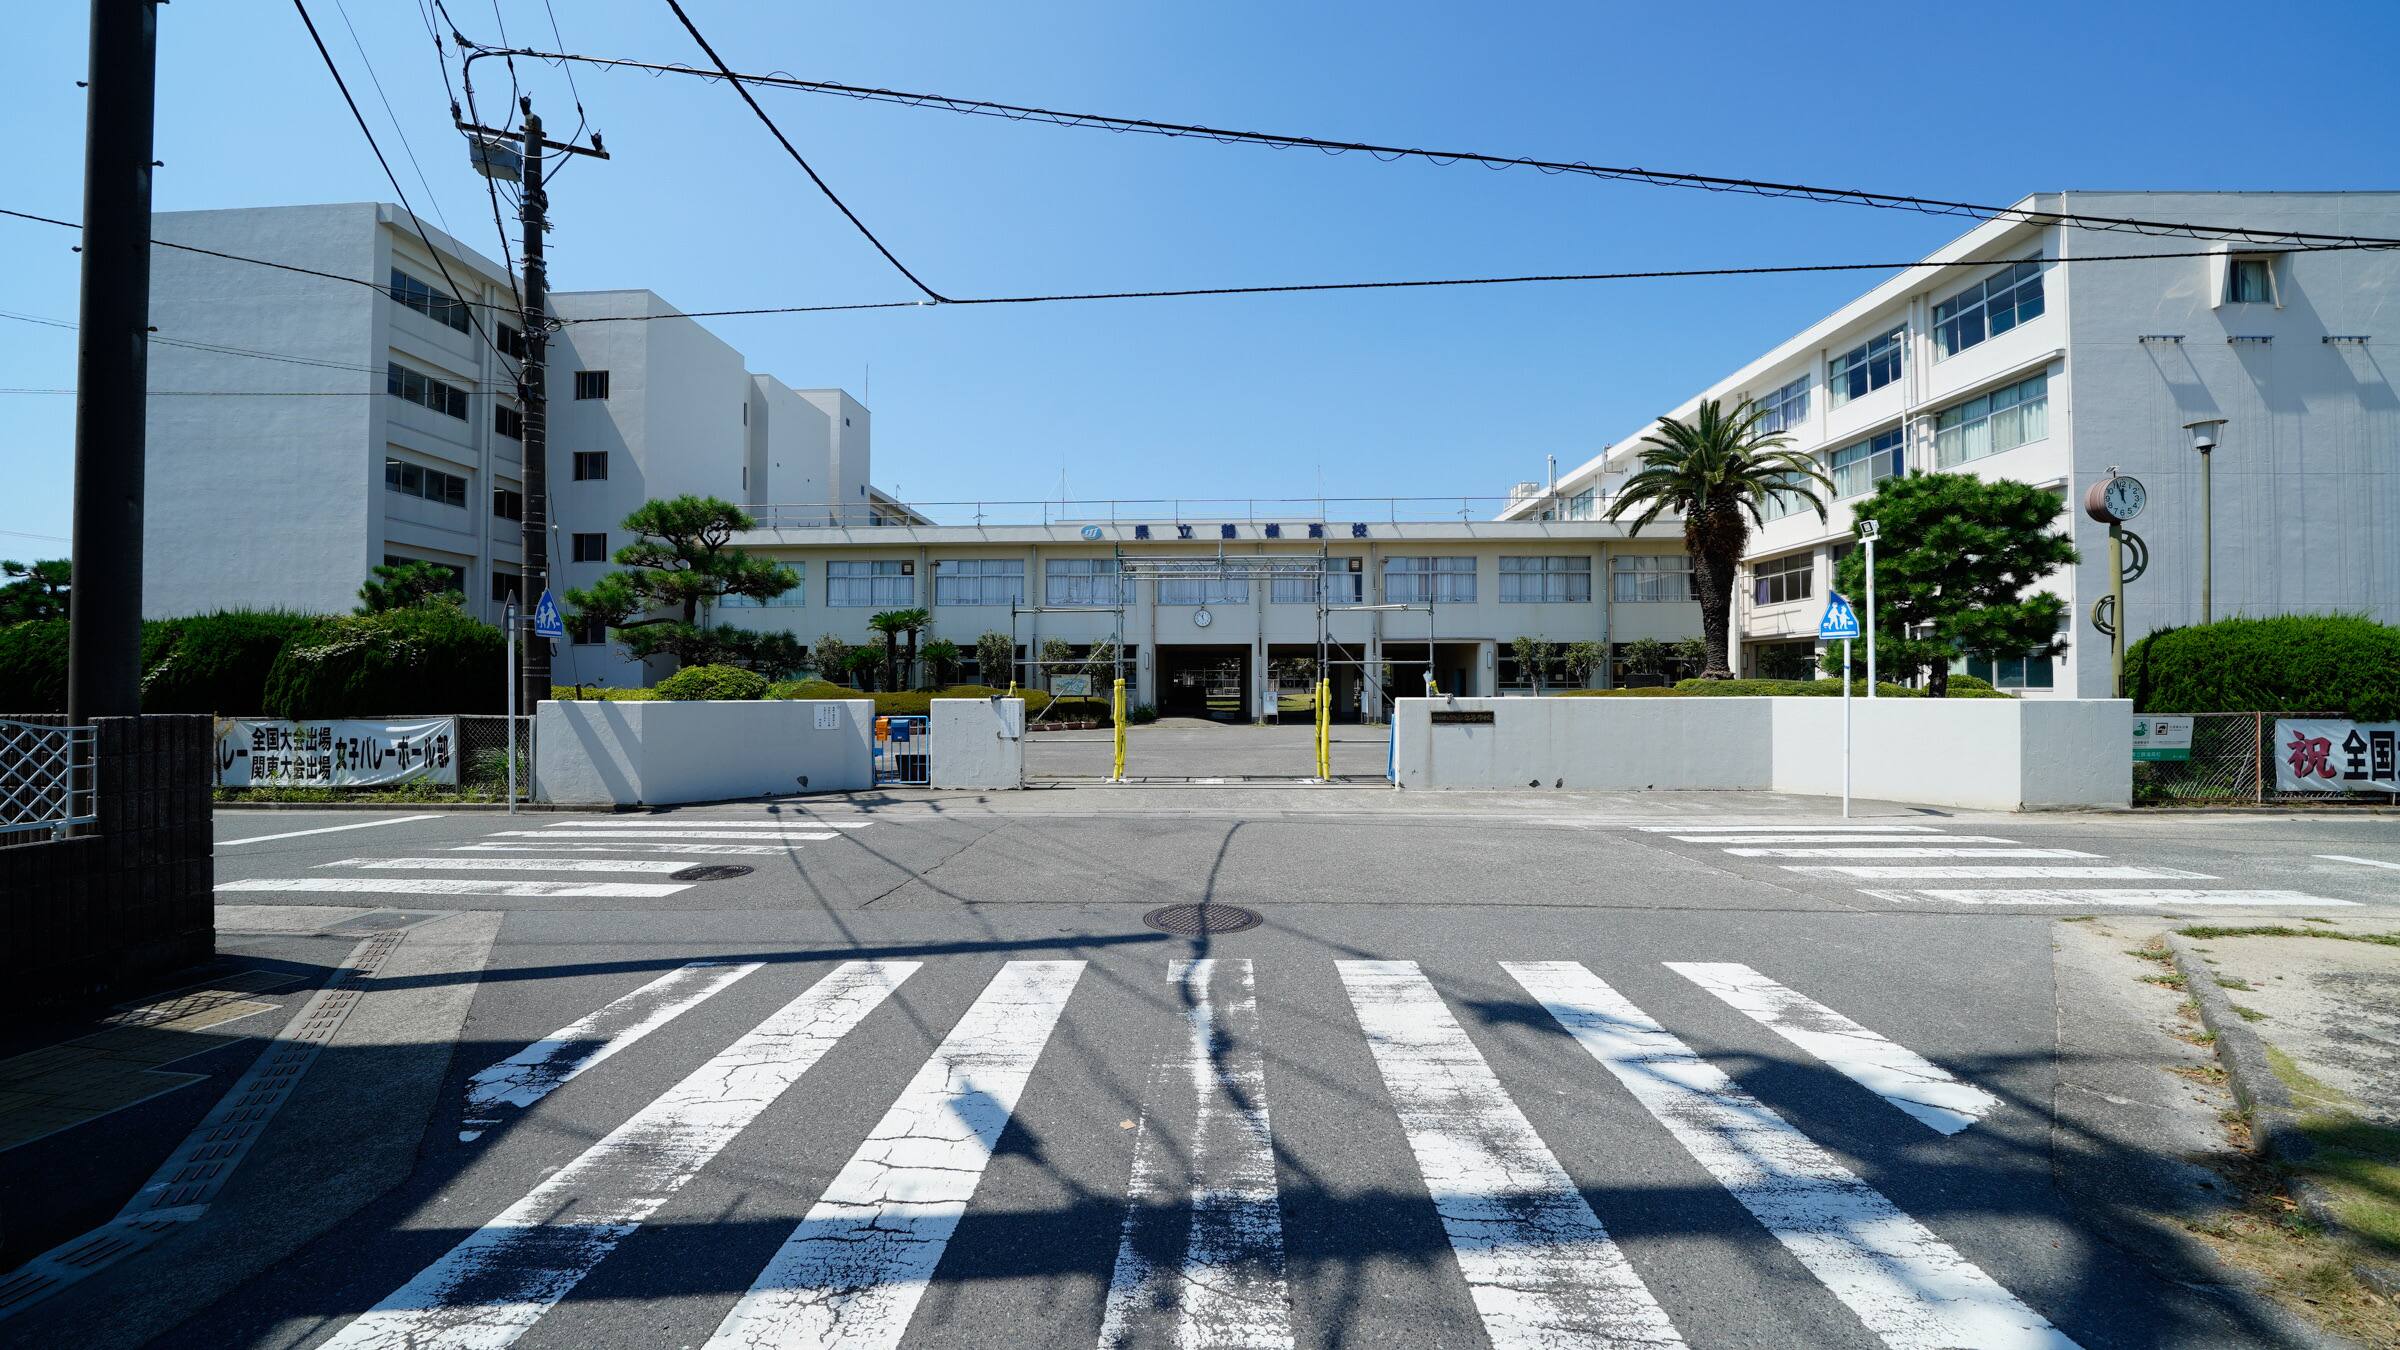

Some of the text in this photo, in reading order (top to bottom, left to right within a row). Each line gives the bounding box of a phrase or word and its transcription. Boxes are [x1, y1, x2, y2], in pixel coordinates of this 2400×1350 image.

[251, 726, 331, 751] 全国大会出場
[335, 735, 449, 770] 女子バレーボール部
[250, 755, 331, 780] 関東大会出場
[2342, 729, 2400, 781] 全国
